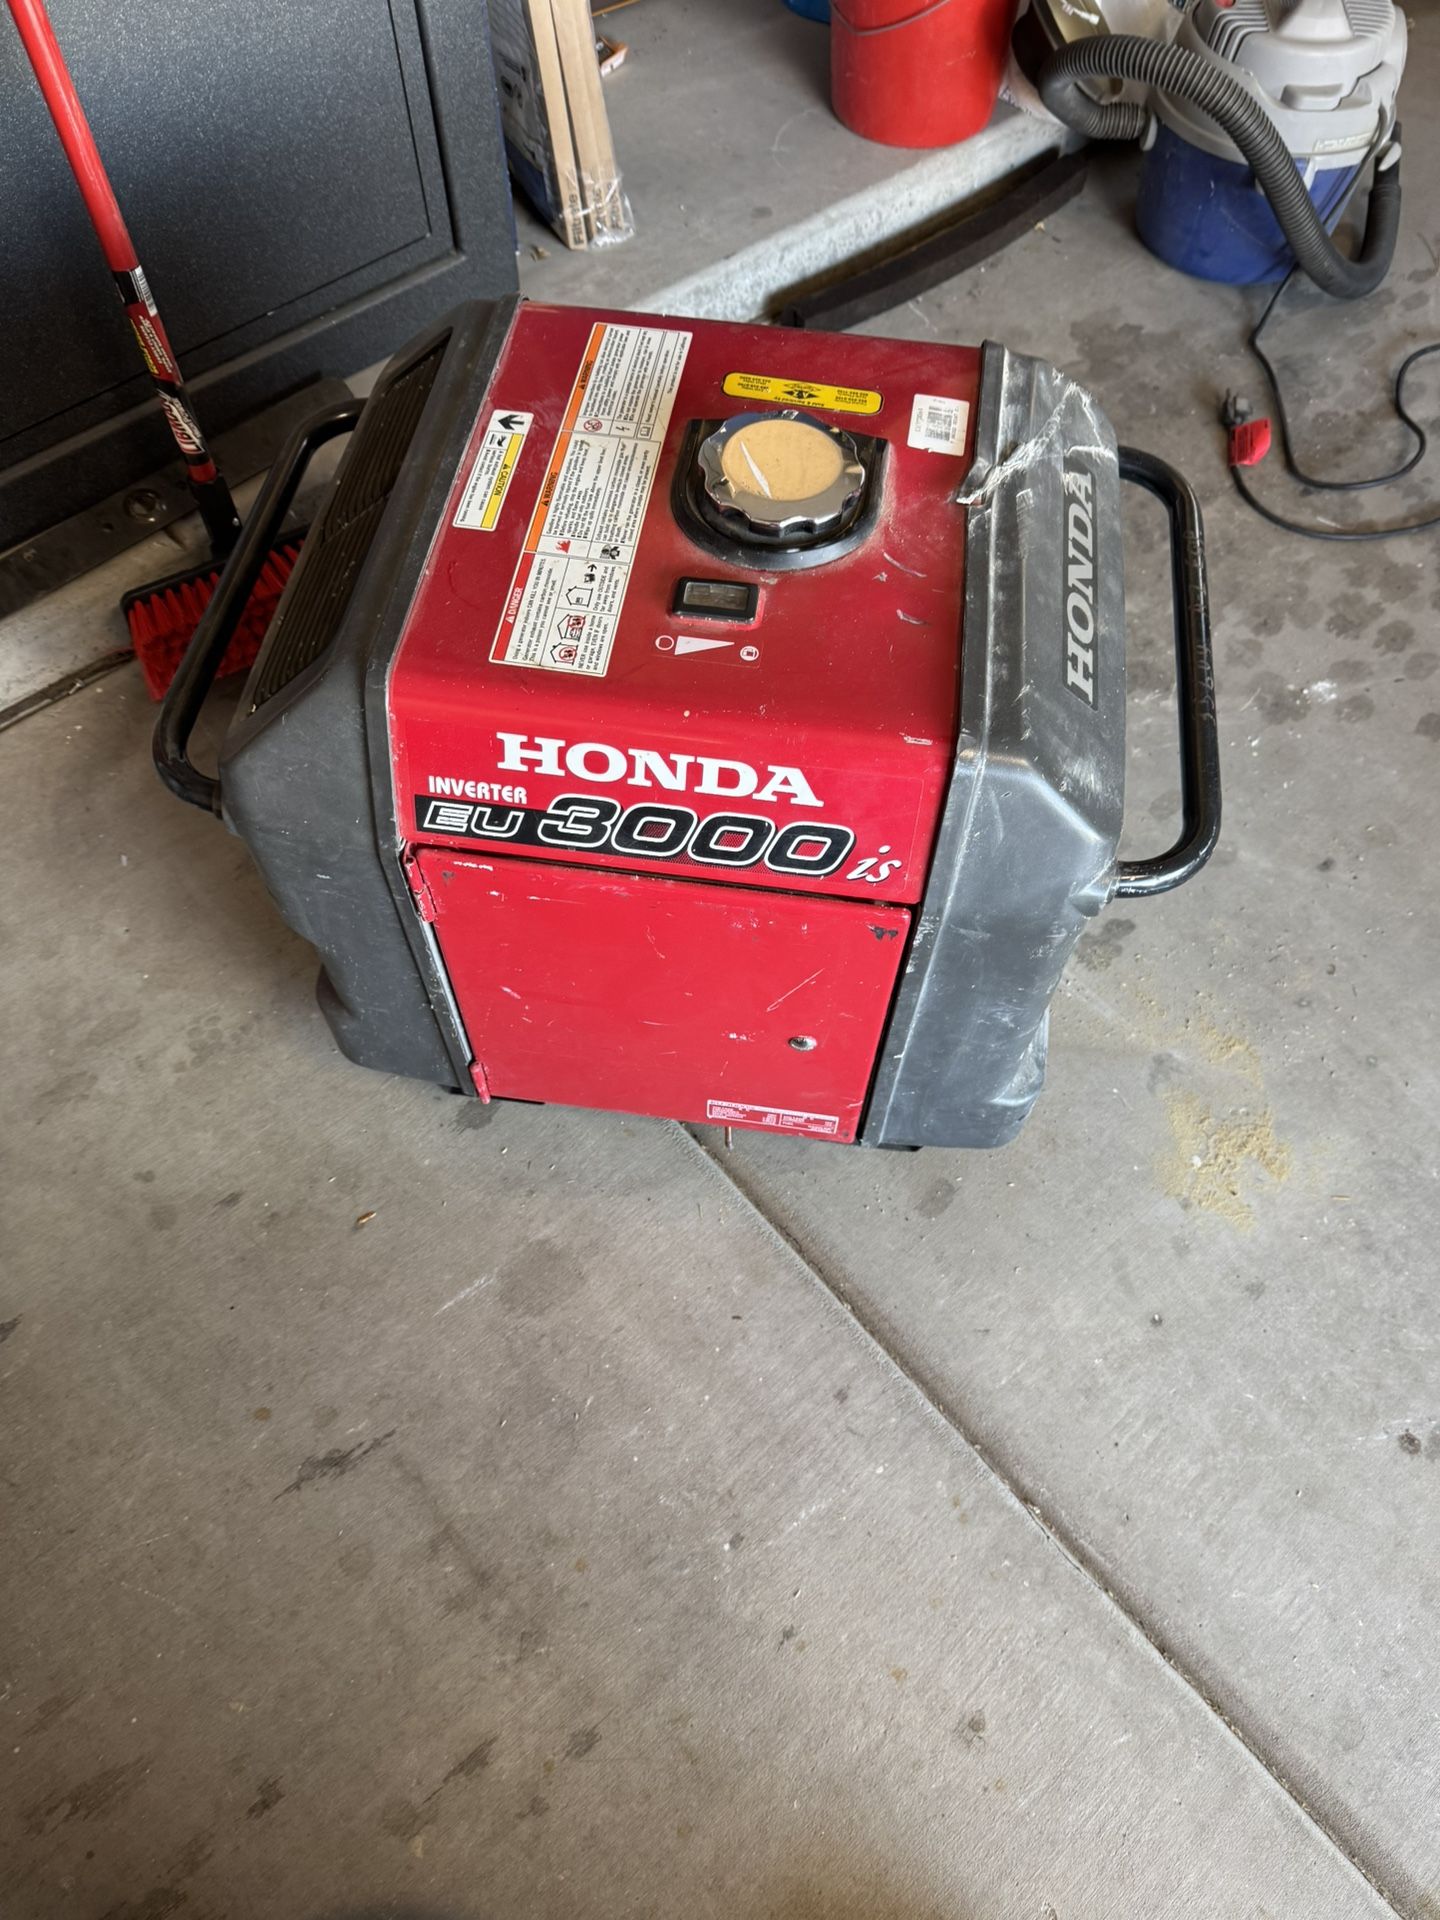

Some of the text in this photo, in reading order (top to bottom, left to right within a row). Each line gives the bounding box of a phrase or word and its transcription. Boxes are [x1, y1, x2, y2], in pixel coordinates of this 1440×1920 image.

[493, 470, 508, 496] CAUTION
[542, 471, 558, 499] WARNING
[506, 586, 523, 614] DANGER
[1067, 471, 1094, 704] HONDA
[497, 732, 824, 807] HONDA
[428, 776, 527, 804] INVERTER
[423, 794, 902, 884] EU 3000 is
